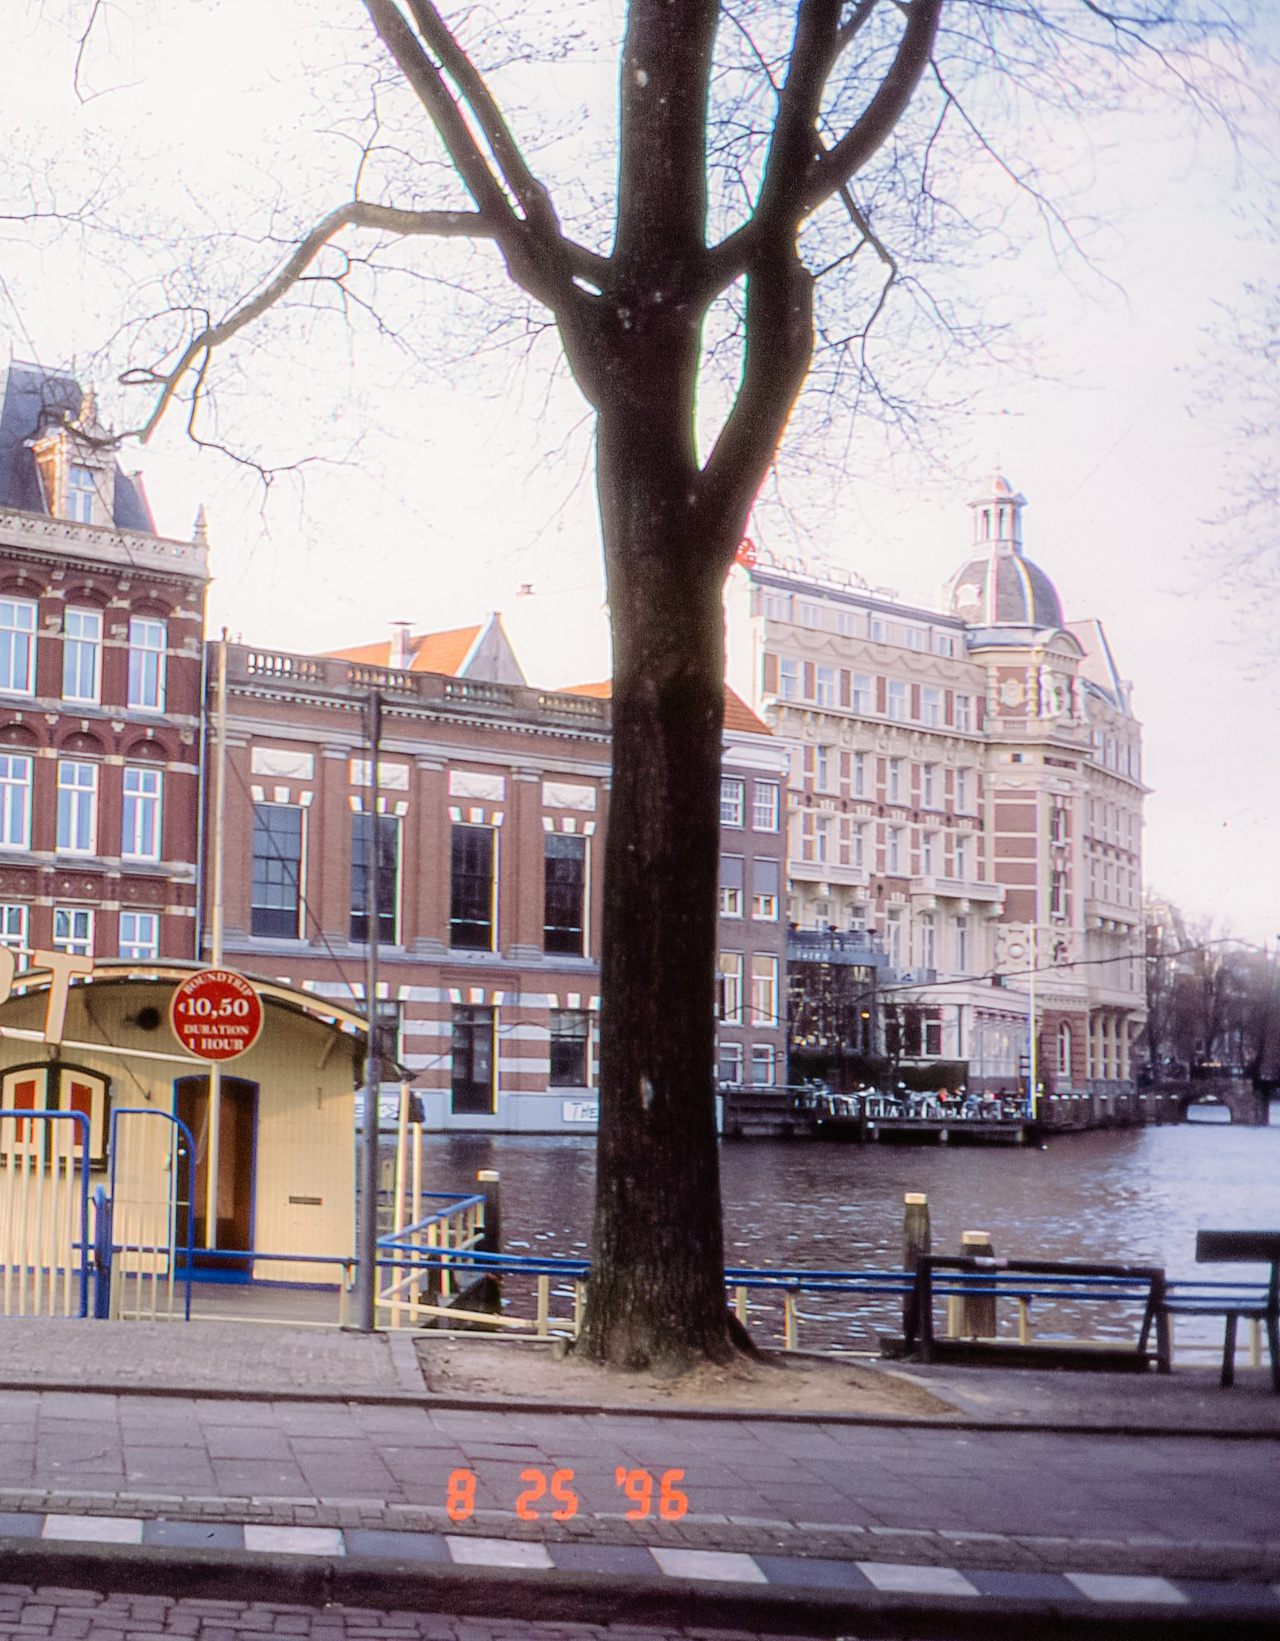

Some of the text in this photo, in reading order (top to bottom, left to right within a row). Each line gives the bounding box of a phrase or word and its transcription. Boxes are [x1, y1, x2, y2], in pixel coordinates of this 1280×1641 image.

[182, 972, 254, 997] ROUNDTRIP
[183, 1024, 249, 1035] DURATION
[188, 1038, 244, 1050] 1 HOUR
